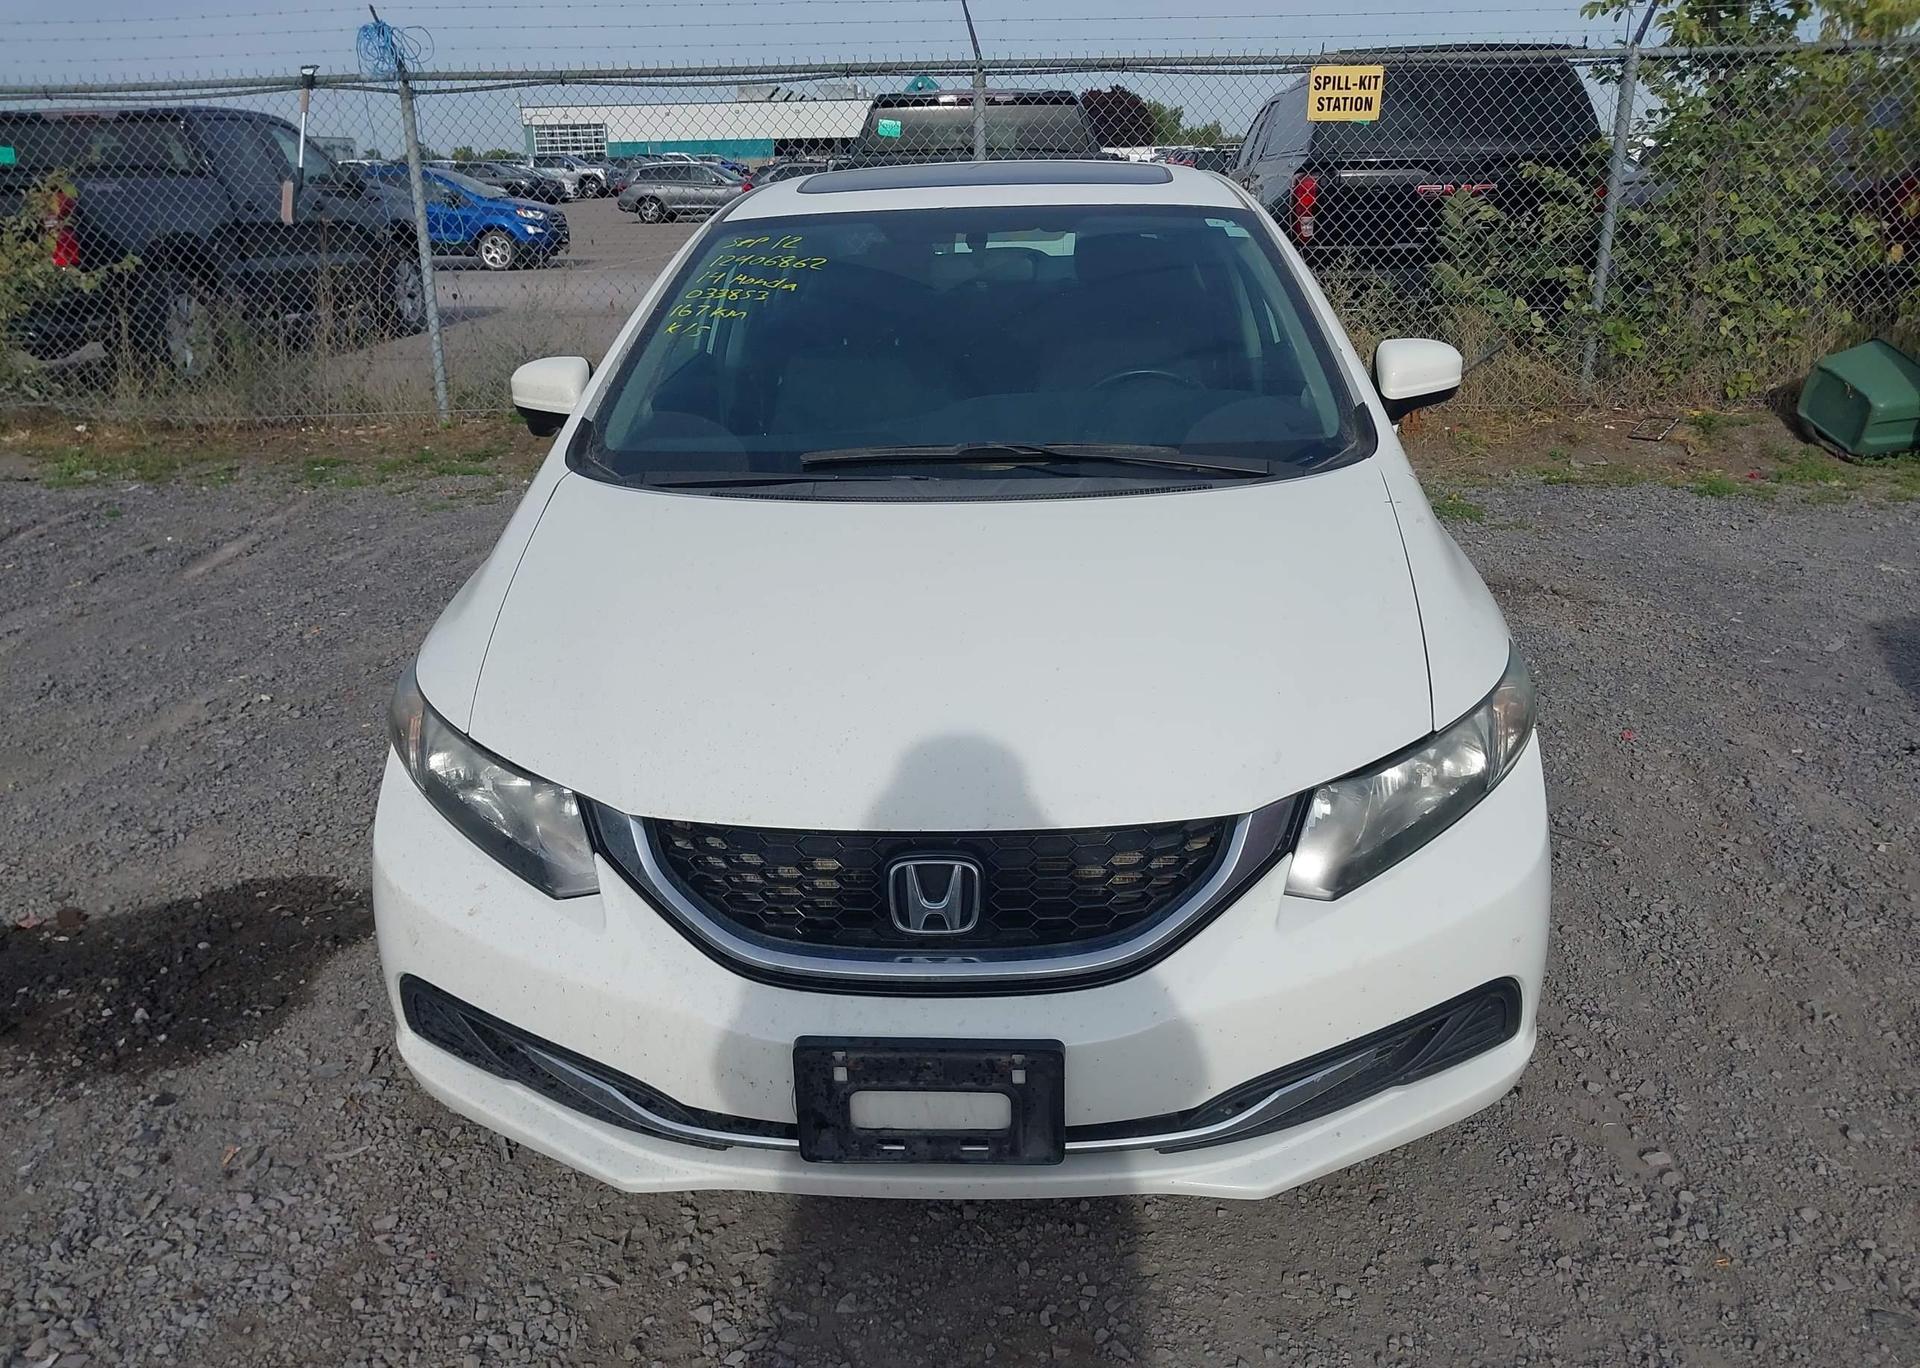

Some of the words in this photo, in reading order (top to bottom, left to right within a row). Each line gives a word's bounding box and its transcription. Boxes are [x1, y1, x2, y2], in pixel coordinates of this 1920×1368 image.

[1313, 75, 1381, 91] SPILL-KIT
[1316, 96, 1374, 112] STATION
[770, 235, 803, 250] 12
[708, 253, 828, 271] 12406862
[695, 270, 727, 285] 14
[729, 273, 798, 292] Honda
